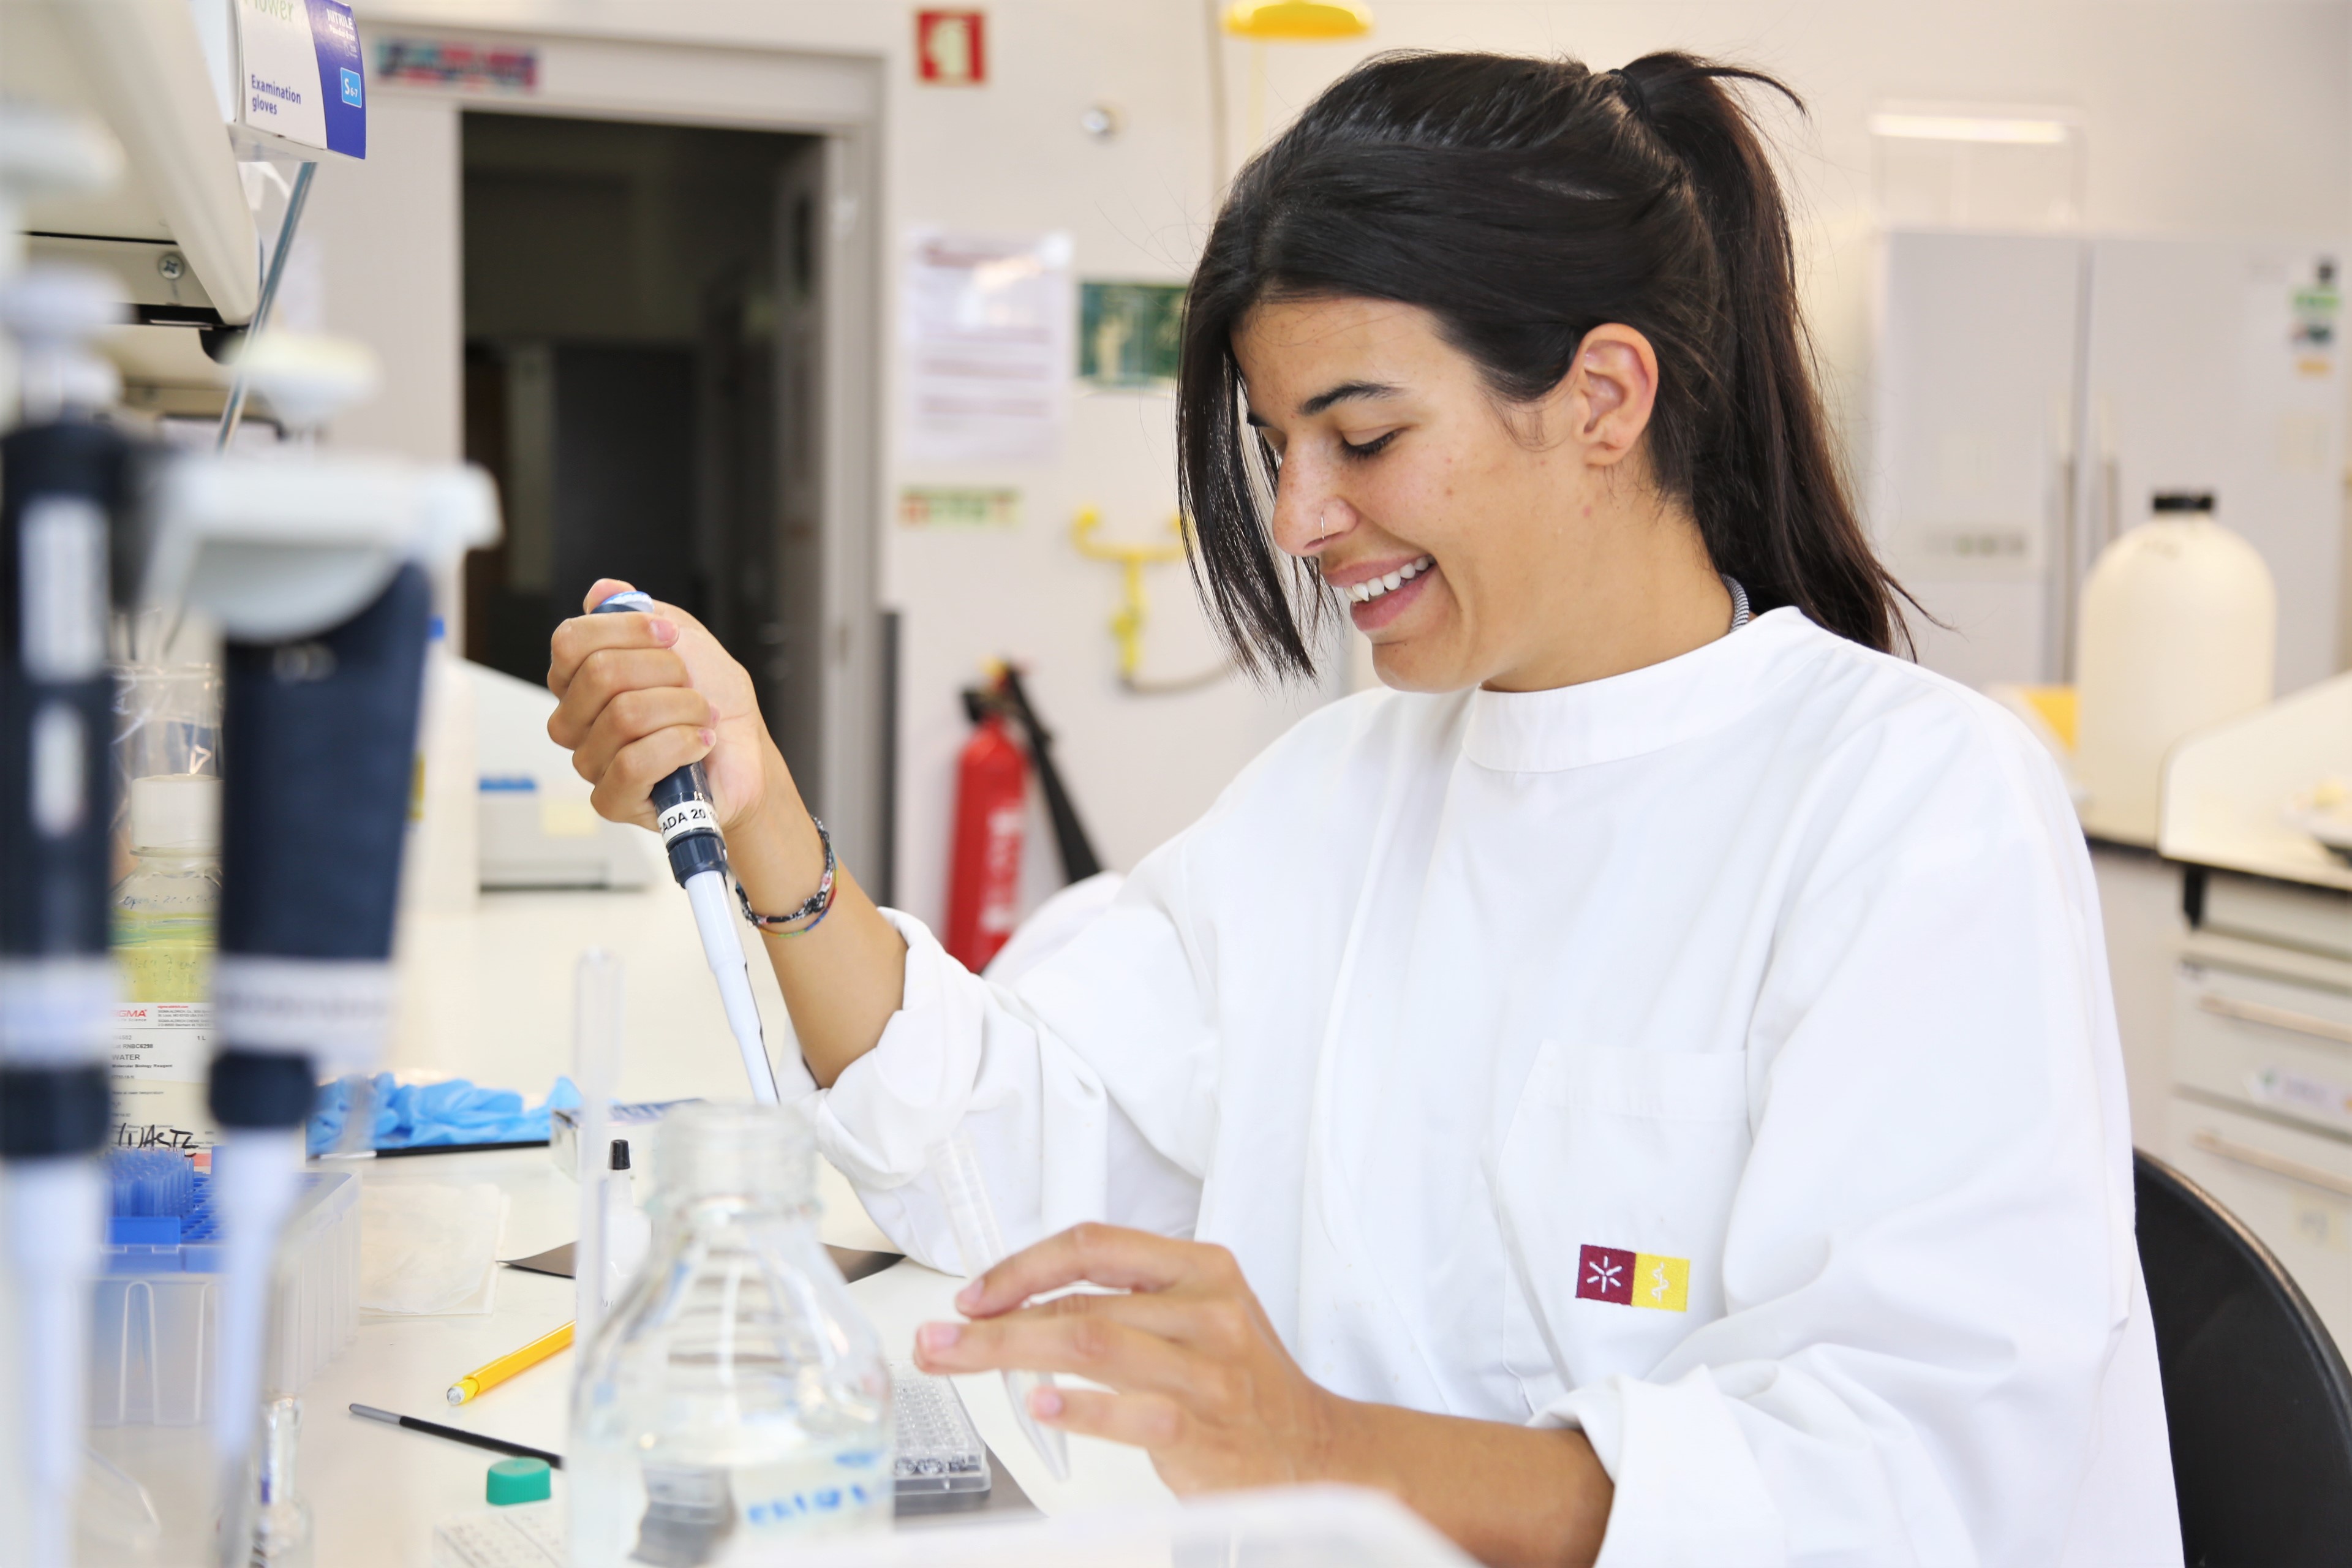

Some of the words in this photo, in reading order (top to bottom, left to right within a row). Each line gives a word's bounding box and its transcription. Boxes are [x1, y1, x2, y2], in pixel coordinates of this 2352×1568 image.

[243, 0, 293, 22] ower
[326, 8, 353, 30] NITRILE
[252, 74, 301, 104] Examination
[252, 94, 277, 115] gloves
[660, 812, 688, 834] ADA
